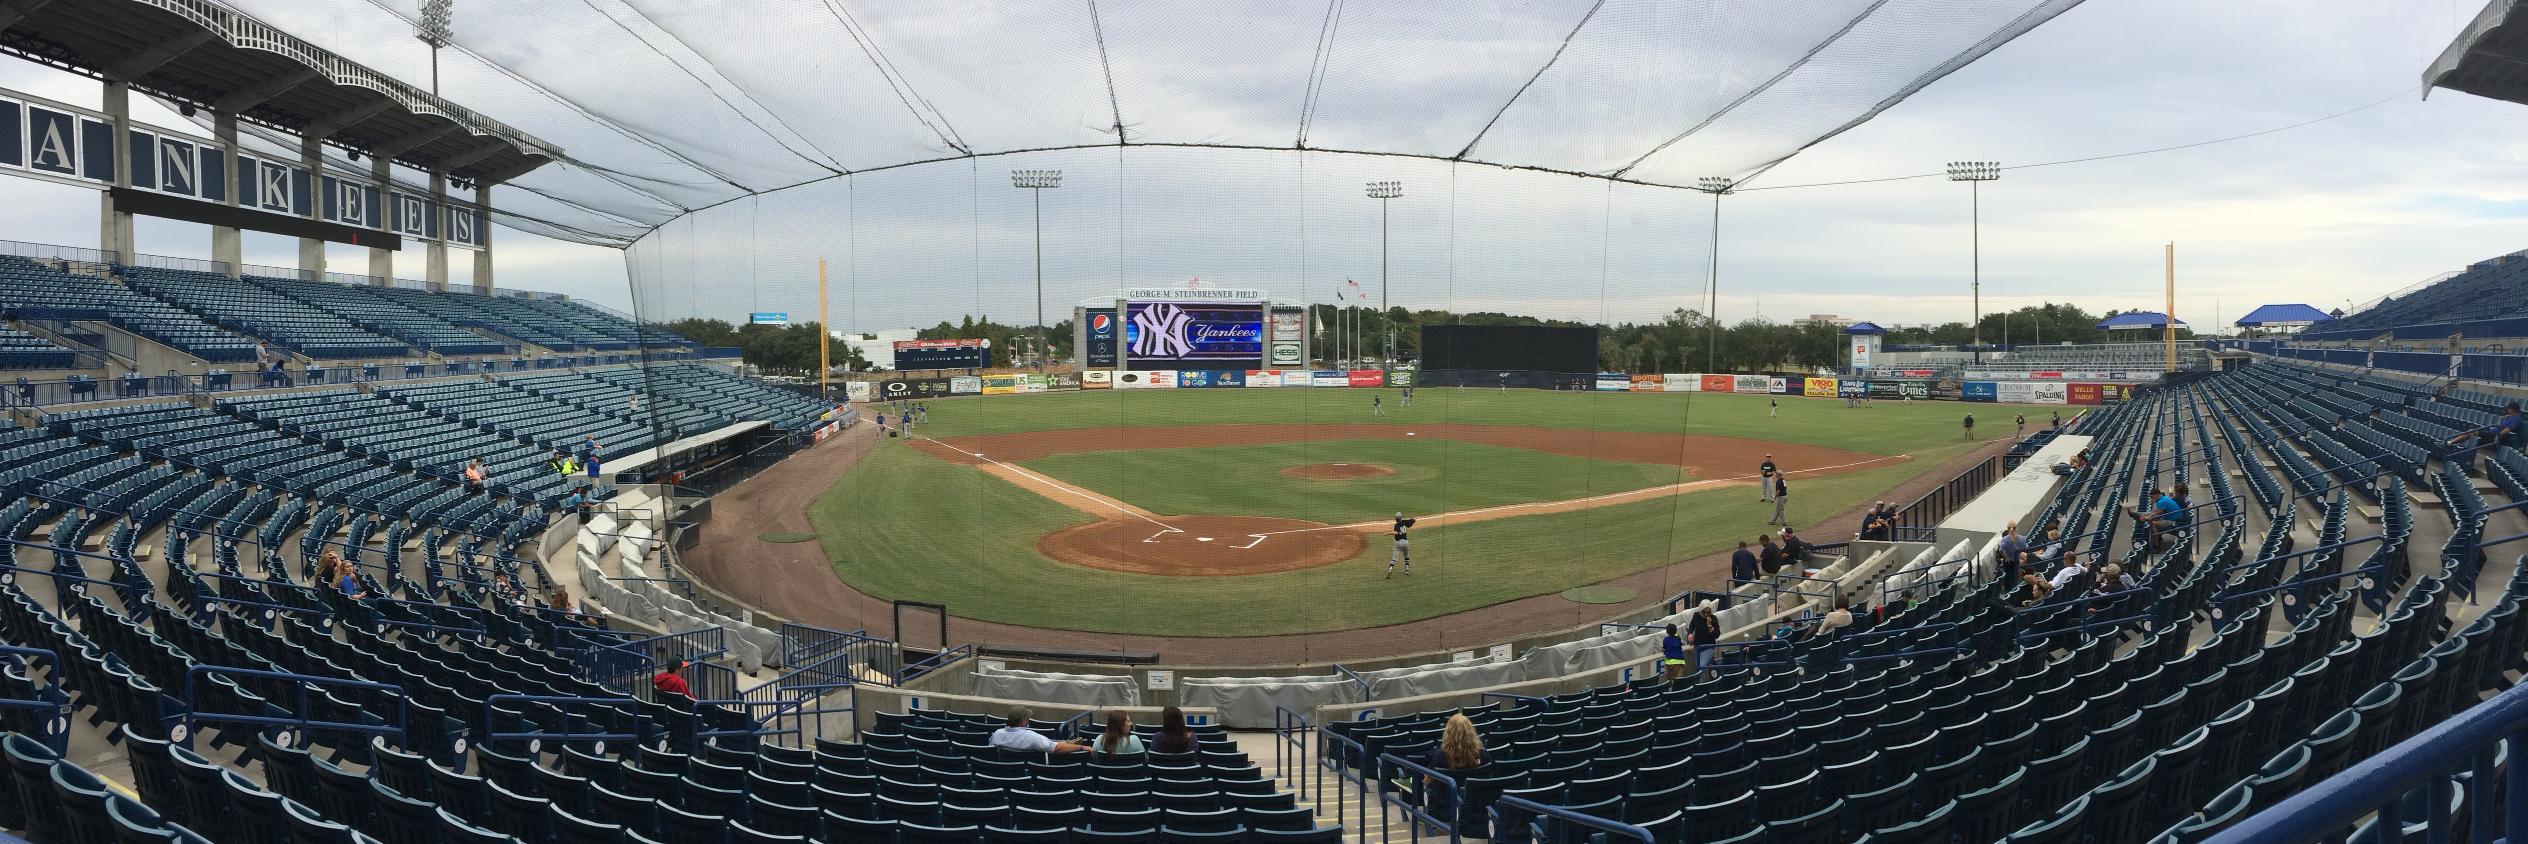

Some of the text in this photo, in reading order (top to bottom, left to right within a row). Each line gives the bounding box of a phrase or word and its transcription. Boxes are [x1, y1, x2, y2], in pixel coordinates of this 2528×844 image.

[1130, 290, 1161, 298] GEORGE
[1174, 290, 1233, 298] STEINBRENNER
[1236, 290, 1258, 298] FIELD
[1196, 324, 1257, 343] Yankees
[1632, 374, 1662, 382] HOOTERS
[1899, 383, 1928, 396] Times
[2035, 391, 2065, 401] SPALDING
